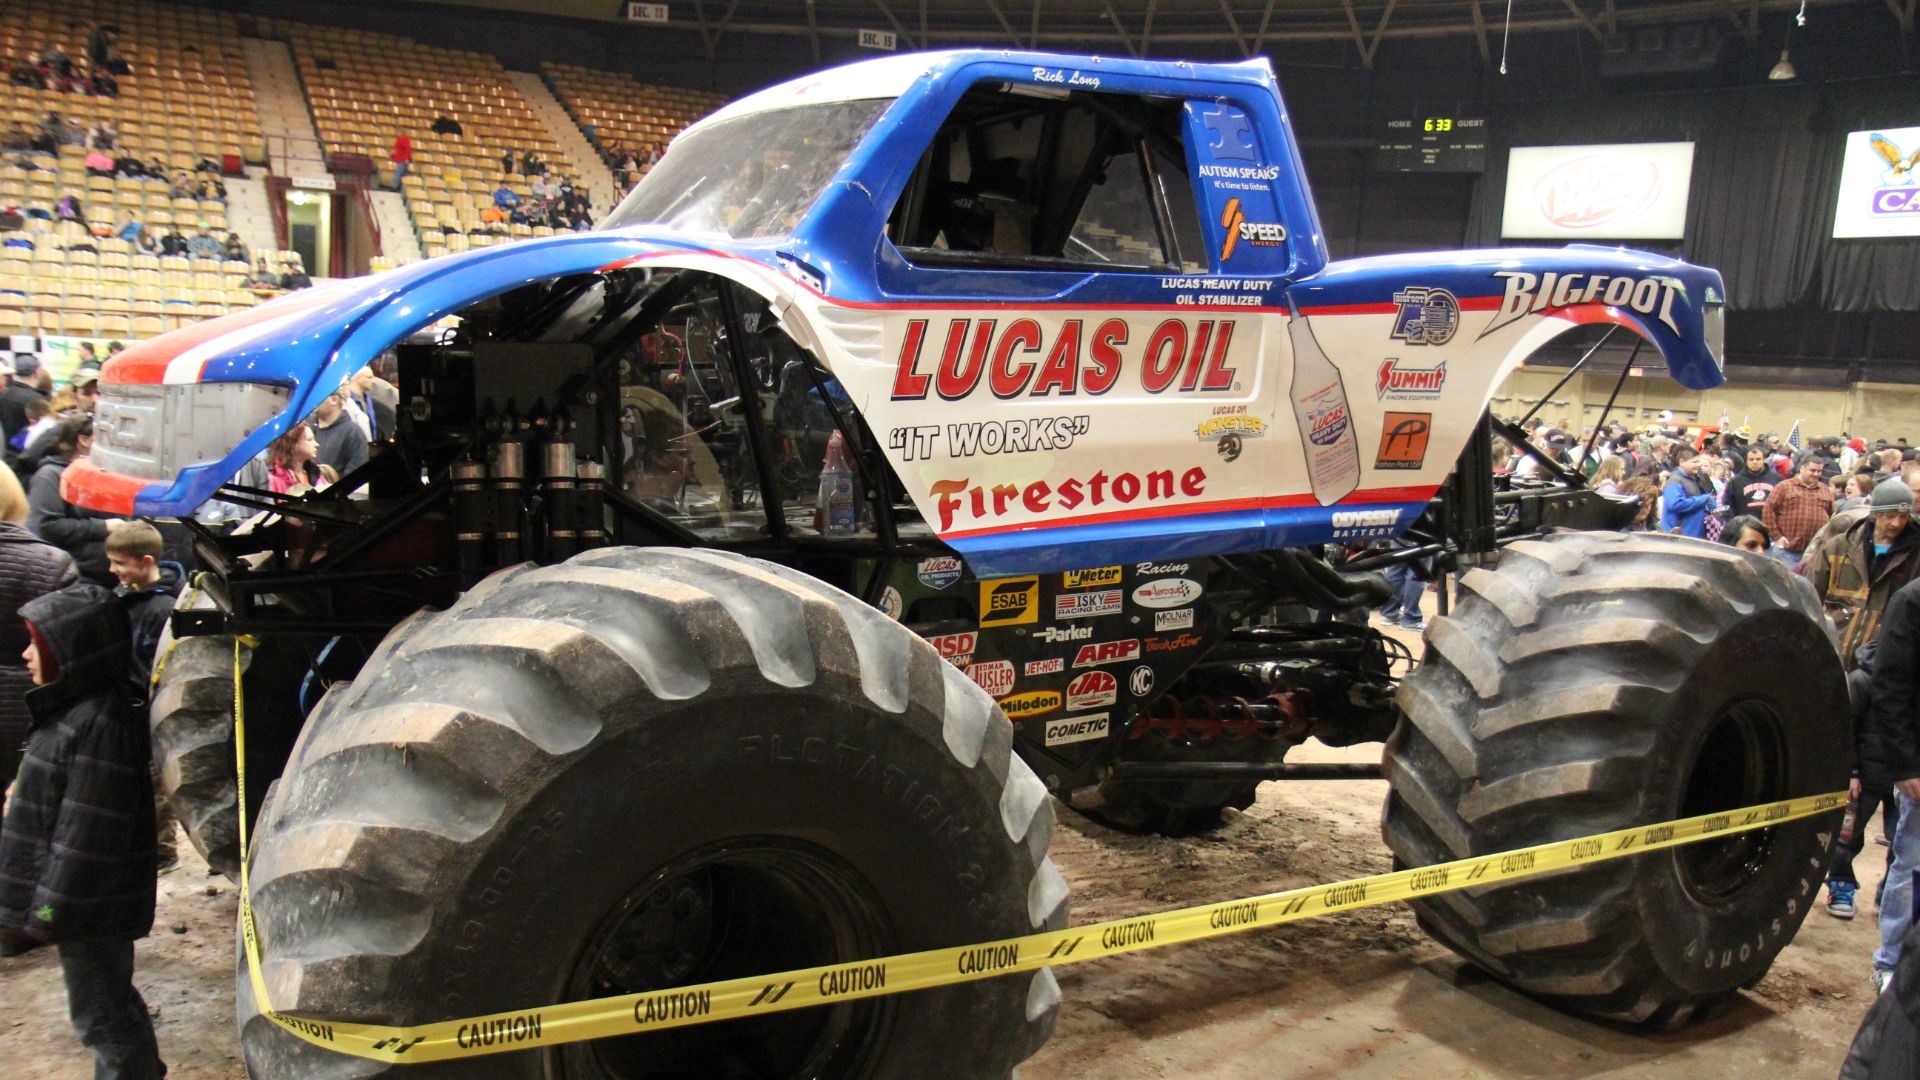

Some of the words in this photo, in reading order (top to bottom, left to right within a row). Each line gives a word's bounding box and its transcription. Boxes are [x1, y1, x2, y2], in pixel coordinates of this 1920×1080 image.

[862, 32, 880, 46] SEC.
[1032, 67, 1064, 83] Rick
[1068, 71, 1101, 89] Long
[1199, 165, 1239, 178] AUTISM
[1240, 167, 1278, 180] SPEAKS
[1241, 182, 1249, 190] to
[1250, 182, 1270, 191] listen.
[1239, 223, 1287, 241] SPEED
[1161, 278, 1200, 289] LUCAS
[1201, 280, 1242, 290] HEAVY
[1243, 281, 1273, 291] DUTY
[1176, 295, 1196, 305] OIL
[1198, 295, 1262, 306] STABILIZER
[1474, 271, 1683, 343] BIGFOOT
[890, 318, 1130, 401] LUCAS
[1141, 318, 1236, 394] OIL
[1213, 406, 1235, 415] LUCAS
[1312, 406, 1345, 432] LUCAS
[929, 466, 1207, 532] Firestone
[1332, 508, 1403, 528] ODYSSEY
[1333, 528, 1394, 538] BATTERY
[924, 560, 957, 572] LUCAS
[1136, 562, 1190, 576] Racing
[1079, 569, 1119, 584] Meter
[991, 593, 1027, 609] ESAB
[1077, 594, 1105, 607] ISKY
[1058, 607, 1093, 615] RACING
[1095, 604, 1121, 612] CAMS
[1156, 609, 1193, 625] MOLNAR
[1045, 625, 1094, 643] Parker
[1076, 640, 1139, 664] ARP
[1025, 659, 1059, 674] JET-HOT
[1069, 672, 1115, 696] JAZ
[1132, 668, 1151, 694] KC
[1001, 695, 1058, 713] Milodon
[1047, 717, 1108, 739] COMETIC
[457, 1014, 542, 1049] CAUTION
[634, 990, 711, 1024] CAUTION
[819, 964, 887, 997] CAUTION
[958, 944, 1019, 975] CAUTION
[1102, 920, 1155, 949] CAUTION
[1210, 902, 1259, 929] CAUTION
[1324, 882, 1368, 908] CAUTION
[1410, 867, 1449, 891] CAUTION
[1501, 851, 1536, 874] CAUTION
[1570, 839, 1603, 860] CAUTION
[1644, 825, 1675, 845] CAUTION
[1703, 815, 1730, 833] CAUTION
[1764, 804, 1790, 821] CAUTION
